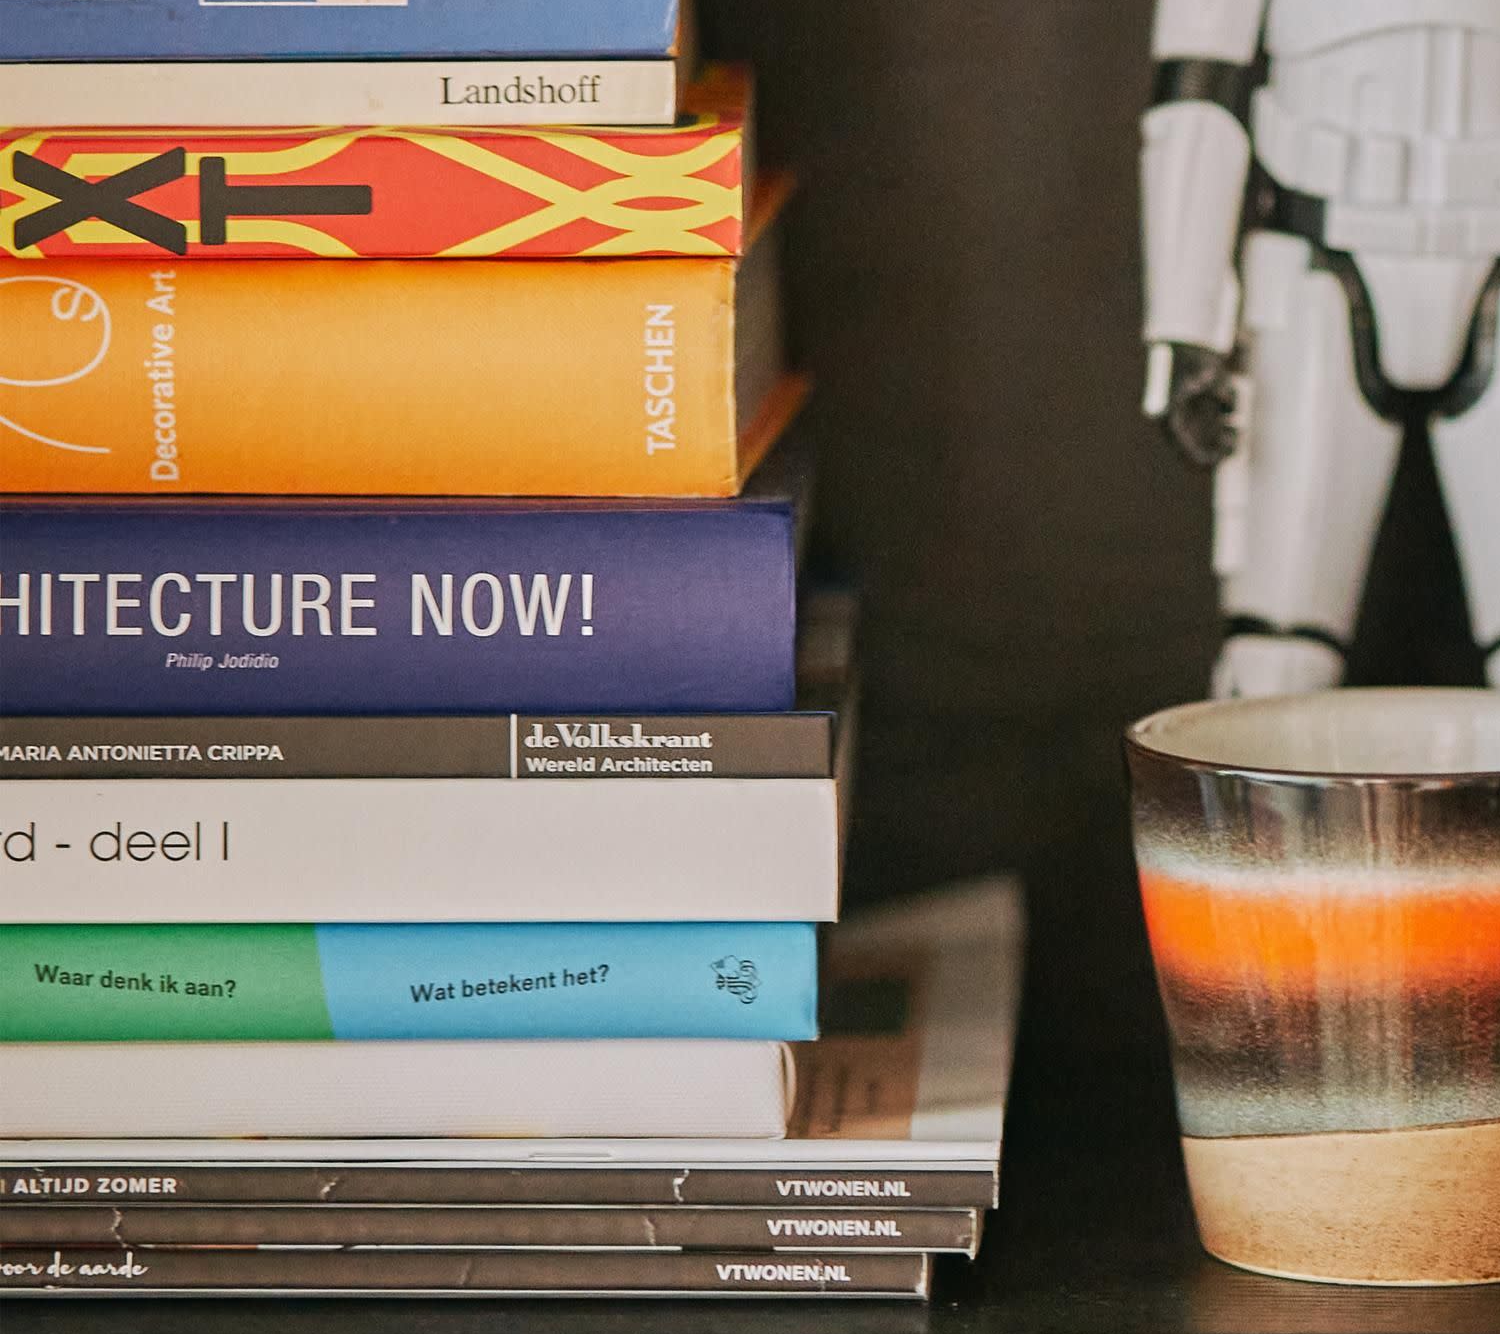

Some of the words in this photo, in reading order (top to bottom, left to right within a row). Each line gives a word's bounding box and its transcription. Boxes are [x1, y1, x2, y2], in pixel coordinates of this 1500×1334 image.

[440, 75, 601, 105] Landshoff
[145, 269, 177, 316] Art
[644, 303, 676, 456] TASCHEN
[144, 323, 180, 481] Decorative
[0, 572, 378, 637] HITECTURE
[411, 573, 596, 637] NOW!
[165, 653, 214, 671] Philip
[218, 653, 280, 669] Jodidio
[66, 745, 202, 761] ANTONIETTA
[207, 745, 285, 761] CRIPPA
[525, 757, 596, 772] Wereld
[600, 757, 713, 772] Architecten
[0, 821, 35, 861] d
[90, 821, 201, 861] deel
[34, 963, 94, 987] Waar
[100, 970, 154, 992] denk
[159, 974, 179, 994] ik
[185, 979, 236, 998] aan?
[410, 981, 455, 1003] Wat
[461, 971, 556, 999] betekent
[562, 964, 610, 988] het?
[13, 1178, 90, 1194] ALTIJD
[97, 1178, 177, 1194] ZOMER
[776, 1180, 911, 1196] VTWONEN.NL
[767, 1219, 902, 1236] VTWONEN.NL
[0, 1263, 44, 1276] oor
[47, 1251, 77, 1278] de
[79, 1251, 149, 1278] aarde
[716, 1265, 851, 1281] VTWONEN.NL
